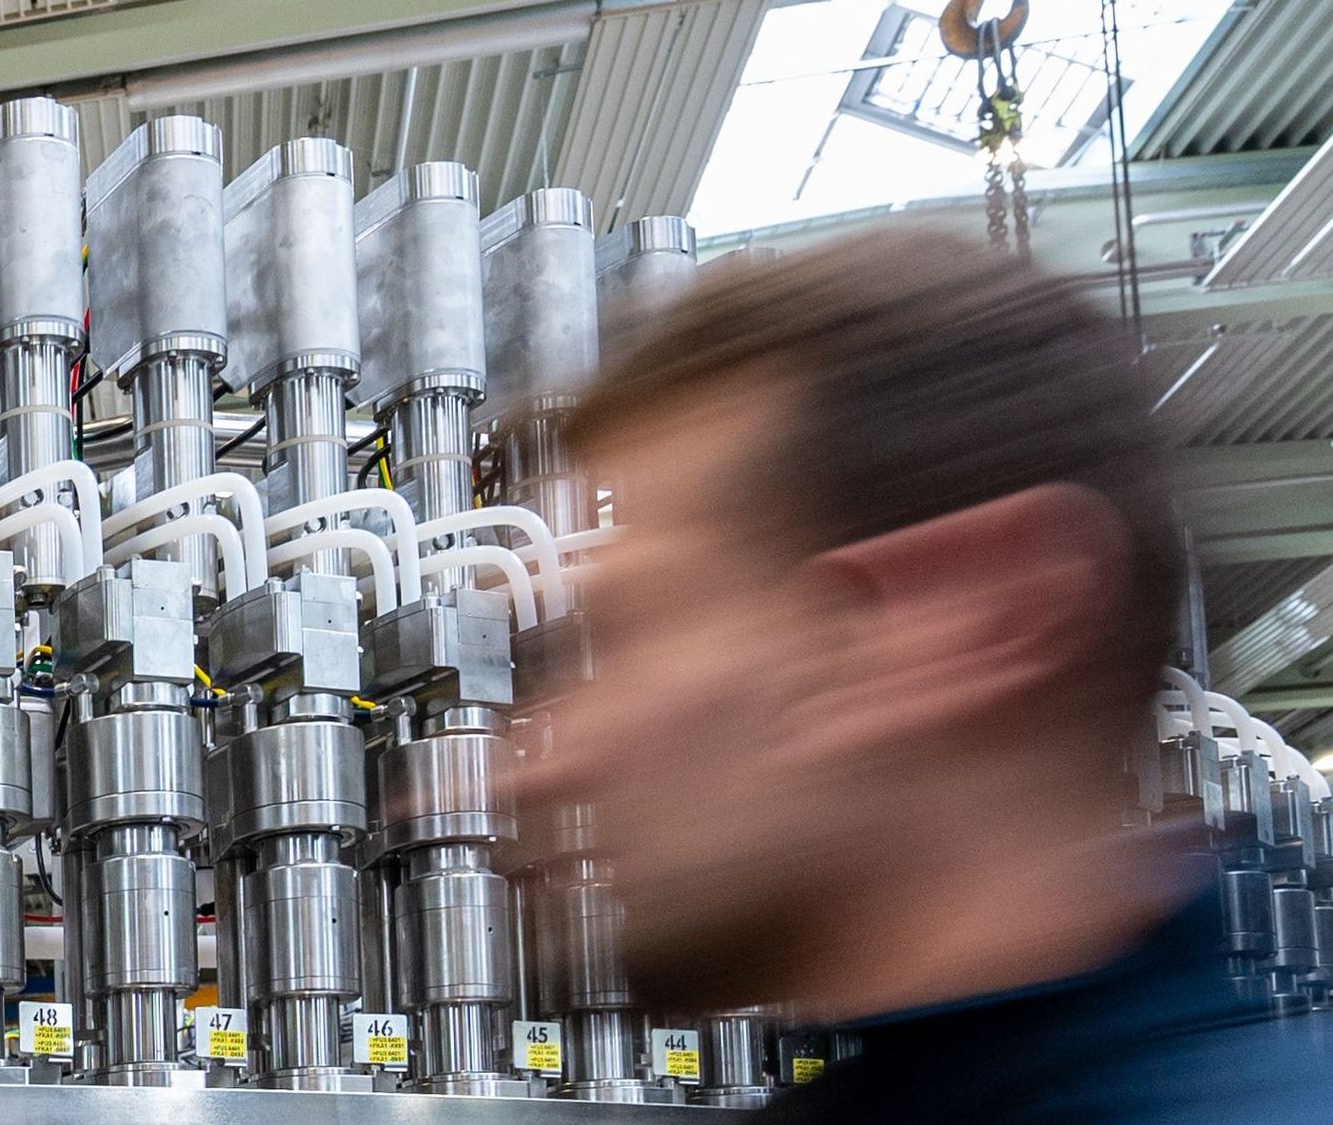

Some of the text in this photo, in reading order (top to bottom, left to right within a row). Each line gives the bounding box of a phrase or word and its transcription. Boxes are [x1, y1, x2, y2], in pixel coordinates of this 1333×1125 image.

[33, 1008, 57, 1026] 48
[210, 1014, 232, 1030] 47
[368, 1020, 392, 1036] 46
[527, 1027, 547, 1043] 45
[665, 1035, 687, 1050] 44
